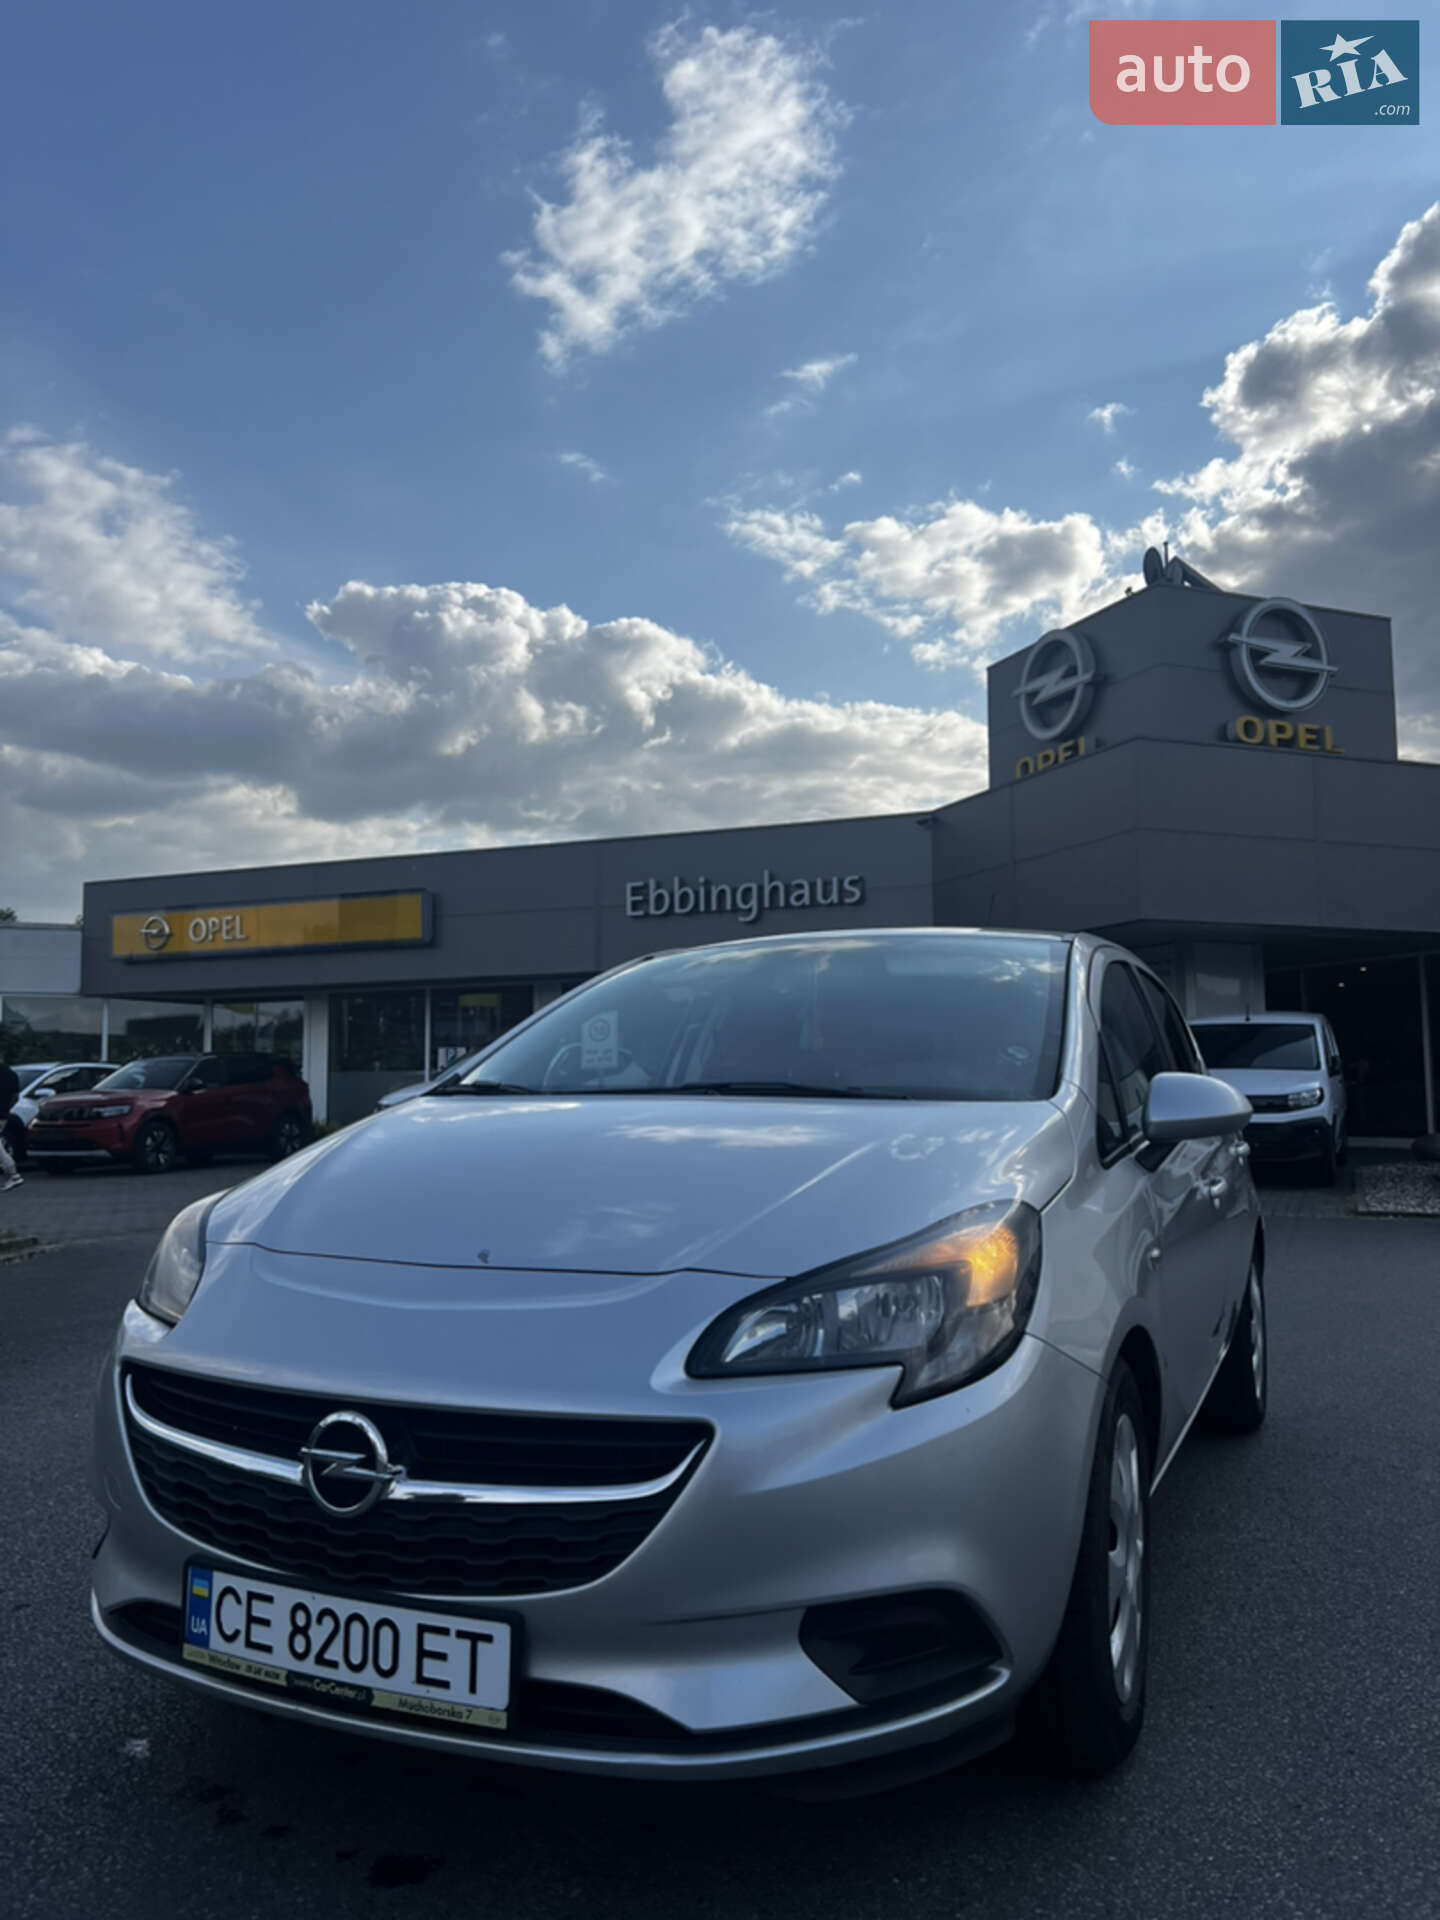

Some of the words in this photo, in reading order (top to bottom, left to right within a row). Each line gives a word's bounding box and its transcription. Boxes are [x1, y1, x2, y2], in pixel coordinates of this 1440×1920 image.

[1235, 715, 1344, 753] OPEL
[624, 871, 863, 921] Ebbinghaus
[188, 915, 246, 943] OPEL
[191, 1615, 208, 1636] UA
[215, 1585, 275, 1654] CE
[288, 1601, 400, 1679] 8200
[416, 1623, 494, 1695] ET
